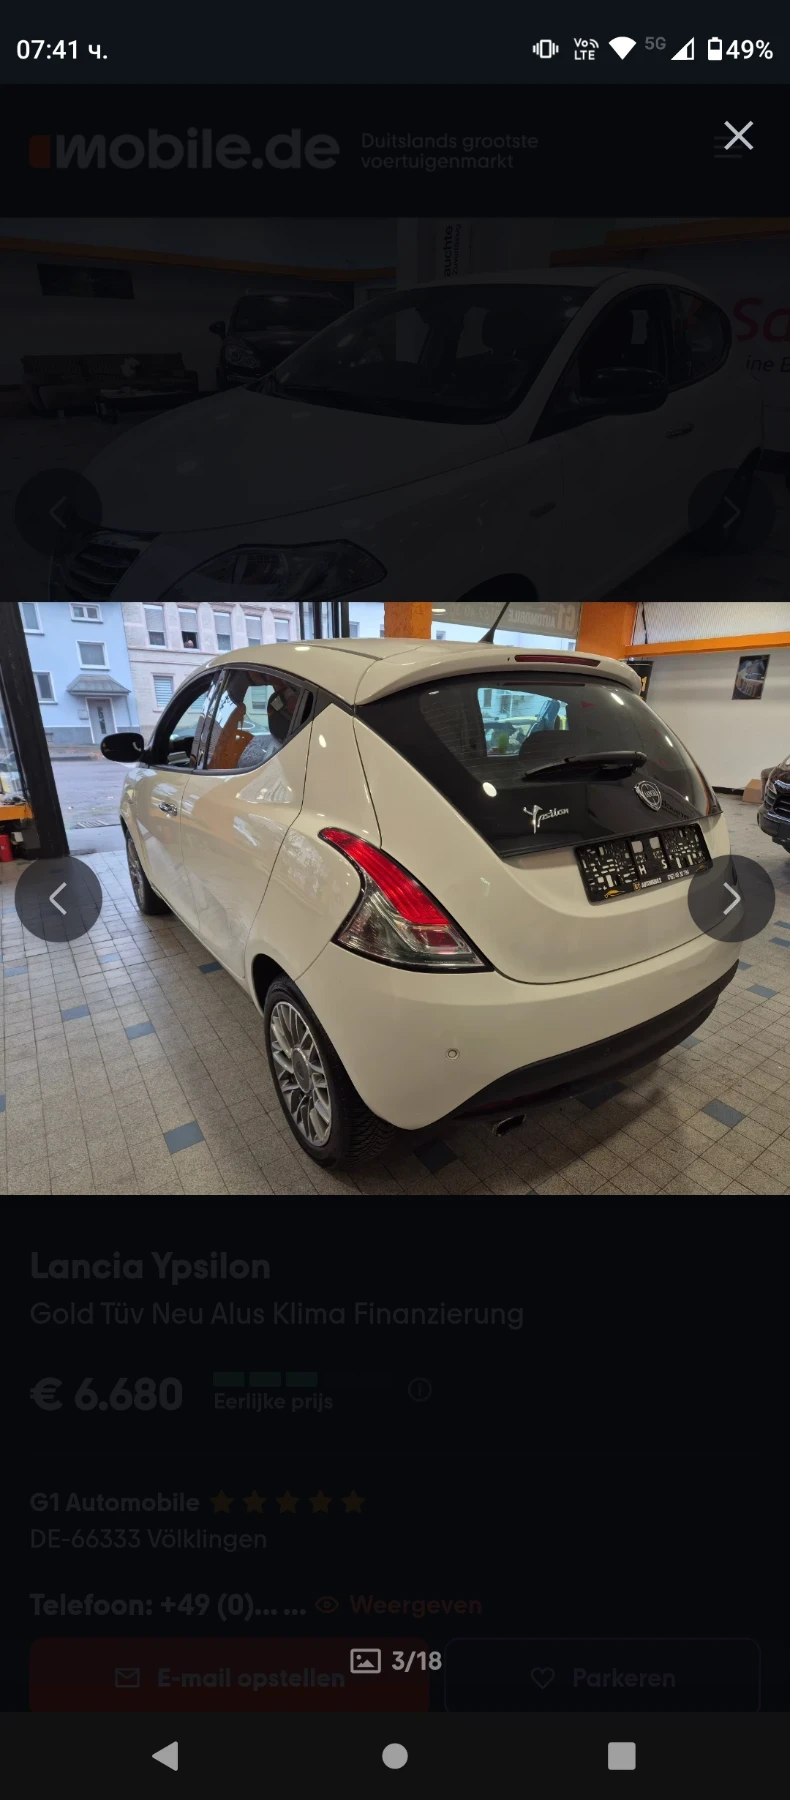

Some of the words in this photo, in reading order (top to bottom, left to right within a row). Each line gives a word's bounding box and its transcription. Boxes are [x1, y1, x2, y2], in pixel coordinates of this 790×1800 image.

[17, 40, 78, 59] 07:41
[88, 43, 108, 59] ч.
[645, 37, 667, 50] 5G
[726, 40, 774, 60] 49%
[574, 50, 596, 61] LTE
[56, 127, 341, 170] mobile.de
[361, 132, 457, 149] Duitslands
[463, 134, 539, 154] grootste
[361, 151, 514, 173] voertuigenmarkt
[443, 225, 453, 279] auchte
[745, 353, 775, 373] ine
[31, 1250, 143, 1280] Lancia
[151, 1251, 271, 1286] Ypsilon
[30, 1301, 94, 1325] Gold
[101, 1301, 145, 1325] Tüv
[153, 1301, 203, 1325] Neu
[210, 1301, 265, 1325] Alus
[273, 1301, 345, 1325] Klima
[355, 1301, 524, 1330] Finanzierung
[30, 1377, 64, 1411] €
[74, 1376, 183, 1412] 6.680
[214, 1392, 286, 1413] Eerlijke
[292, 1392, 334, 1413] prijs
[30, 1492, 59, 1512] G1
[66, 1492, 200, 1512] Automobile
[30, 1528, 141, 1549] DE-66333
[147, 1528, 267, 1553] Völklingen
[30, 1593, 153, 1616] Telefoon:
[161, 1593, 211, 1616] +49
[350, 1594, 482, 1619] Weergeven
[391, 1650, 442, 1673] 3/18
[158, 1667, 231, 1688] E-mail
[237, 1667, 345, 1692] opstellen
[573, 1667, 676, 1688] Parkeren
